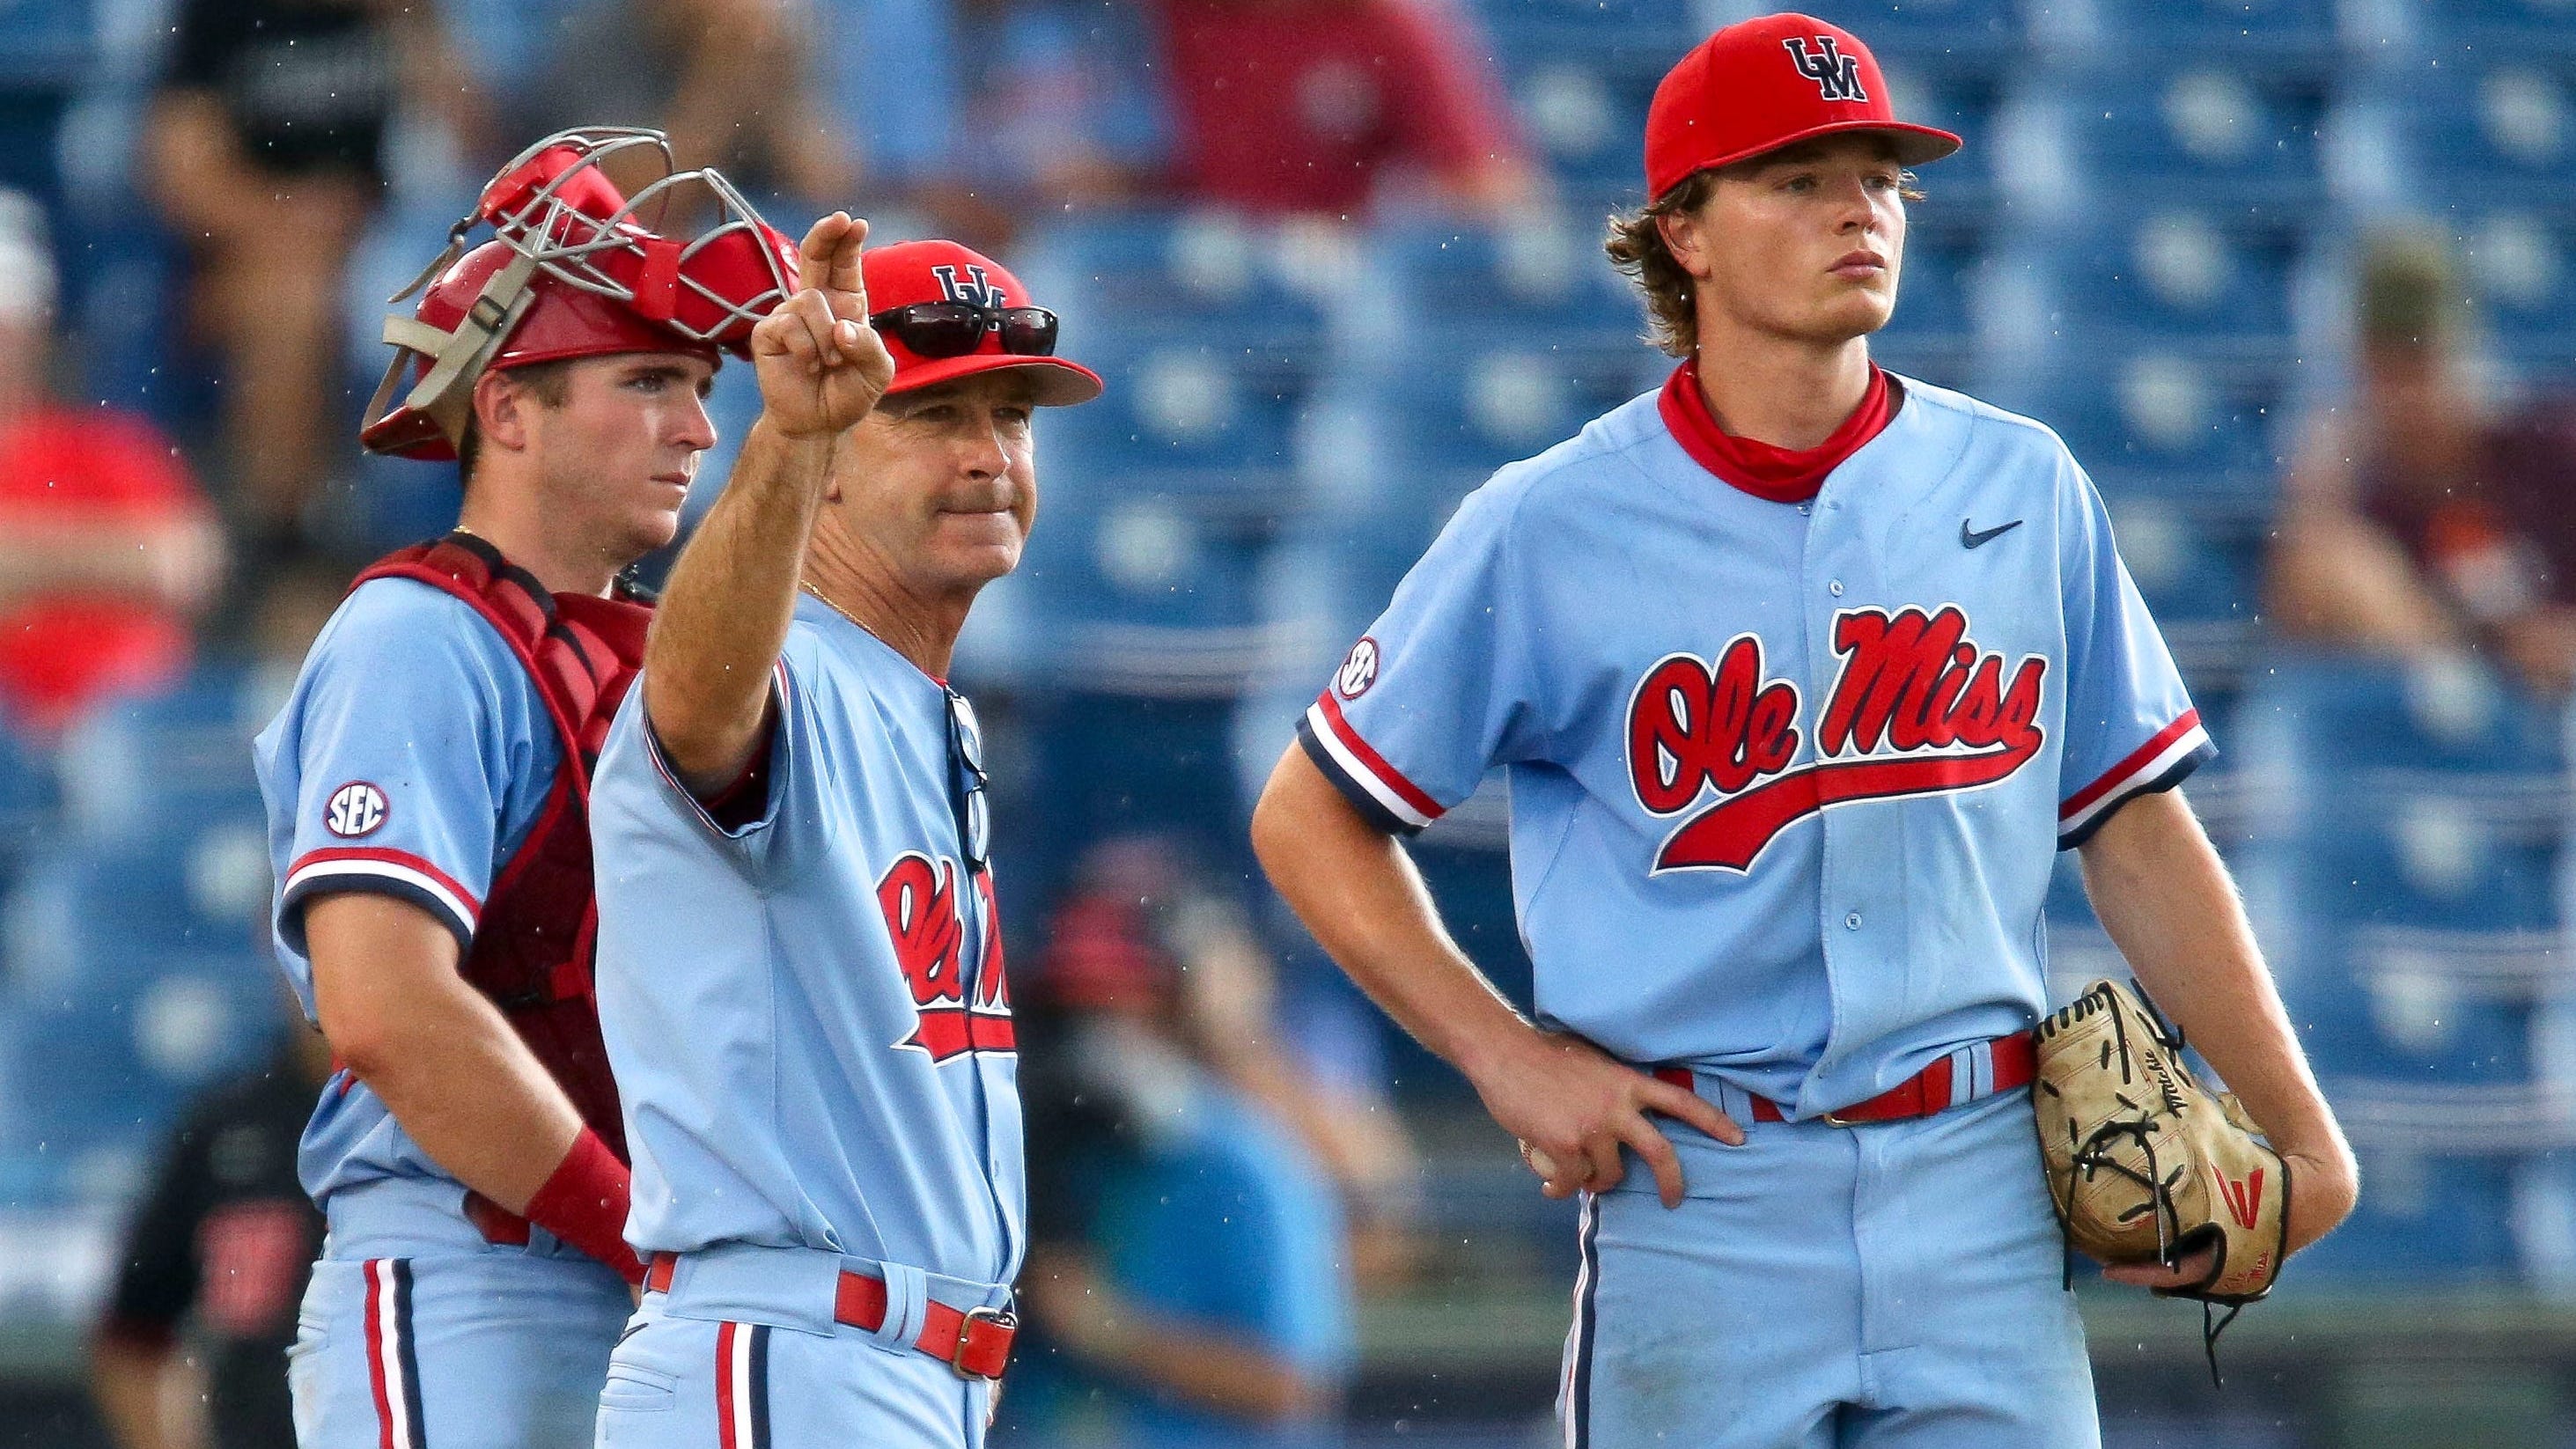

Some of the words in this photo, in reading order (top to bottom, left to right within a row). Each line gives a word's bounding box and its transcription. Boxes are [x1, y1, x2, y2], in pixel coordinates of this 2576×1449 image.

[1782, 35, 1868, 102] UM
[1340, 640, 1375, 695] SEC
[1626, 632, 1802, 819] Ole
[1814, 603, 2049, 759] Miss
[327, 784, 385, 835] SEC
